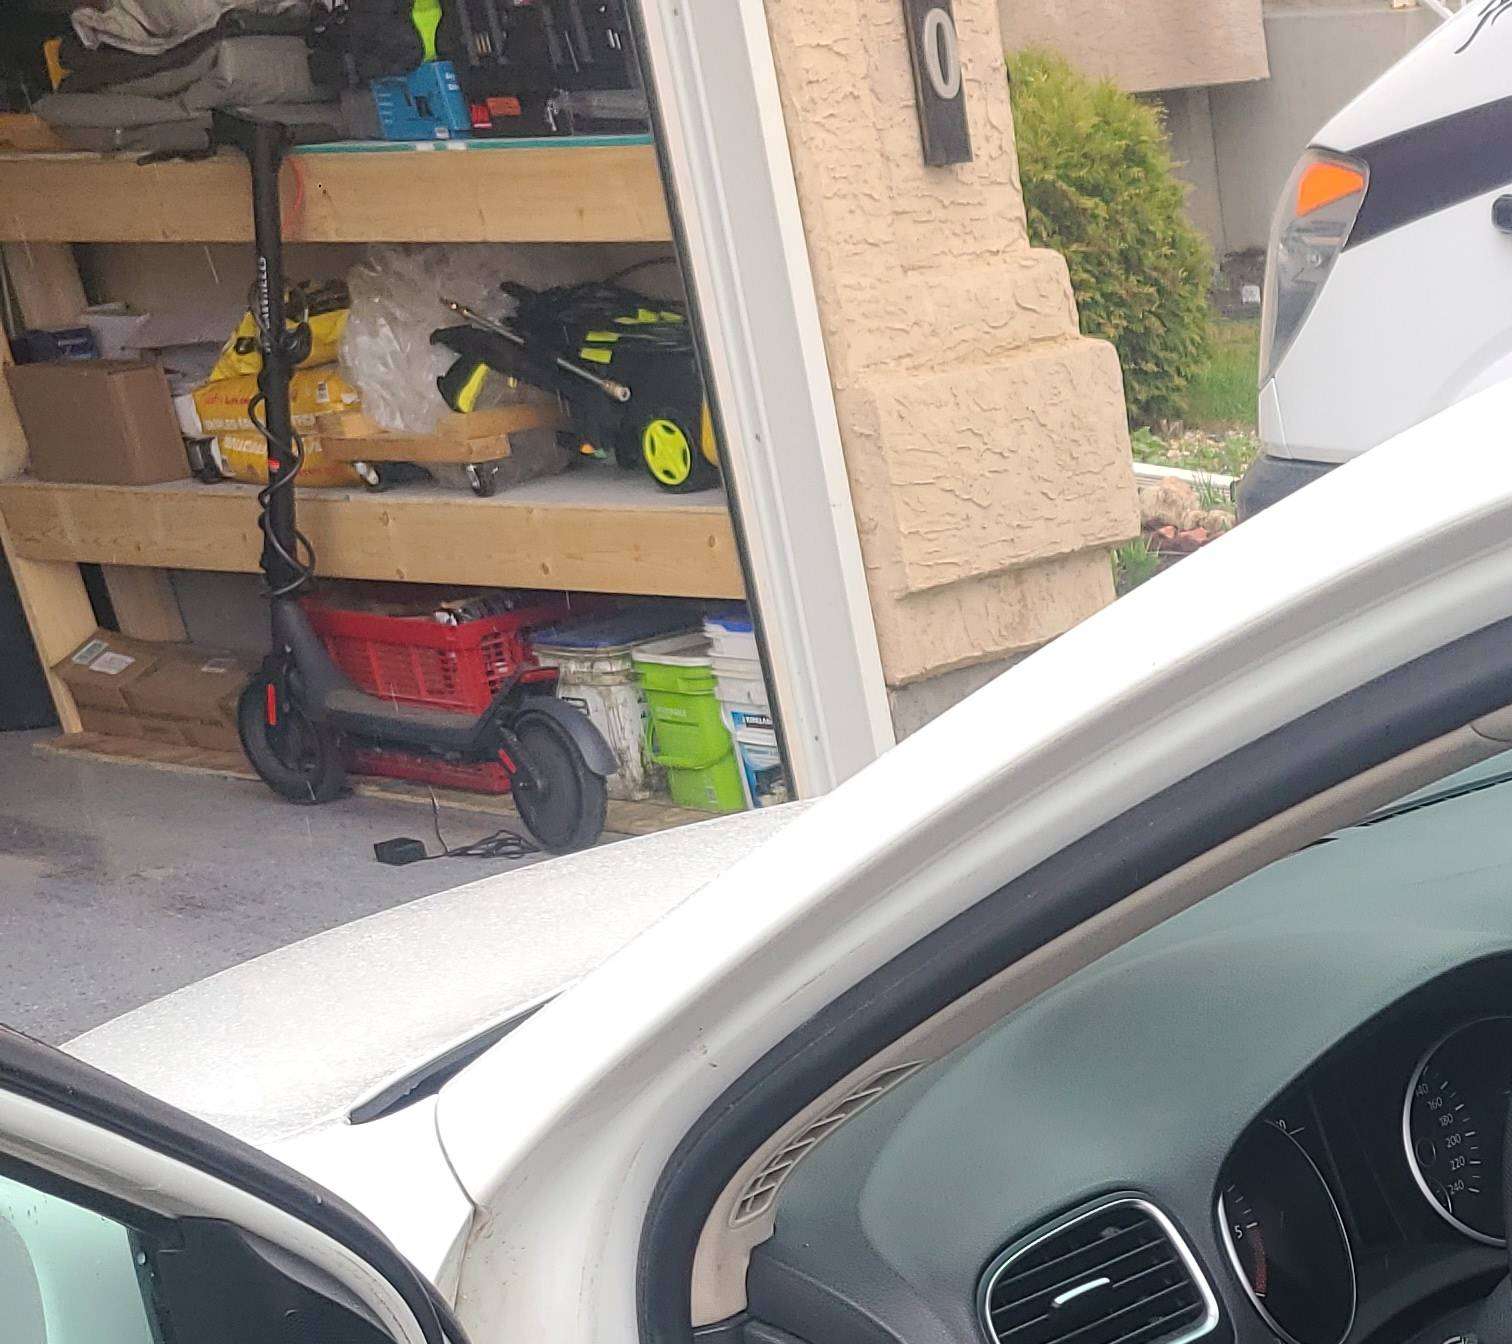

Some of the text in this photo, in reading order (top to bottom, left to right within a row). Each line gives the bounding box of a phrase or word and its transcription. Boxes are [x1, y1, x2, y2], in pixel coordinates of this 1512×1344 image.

[923, 7, 962, 99] 0
[1427, 1096, 1443, 1111] 160
[1439, 1113, 1454, 1127] 180
[1446, 1133, 1461, 1148] 200
[1450, 1155, 1465, 1170] 220
[1448, 1179, 1464, 1195] 240
[1233, 1224, 1243, 1239] 5
